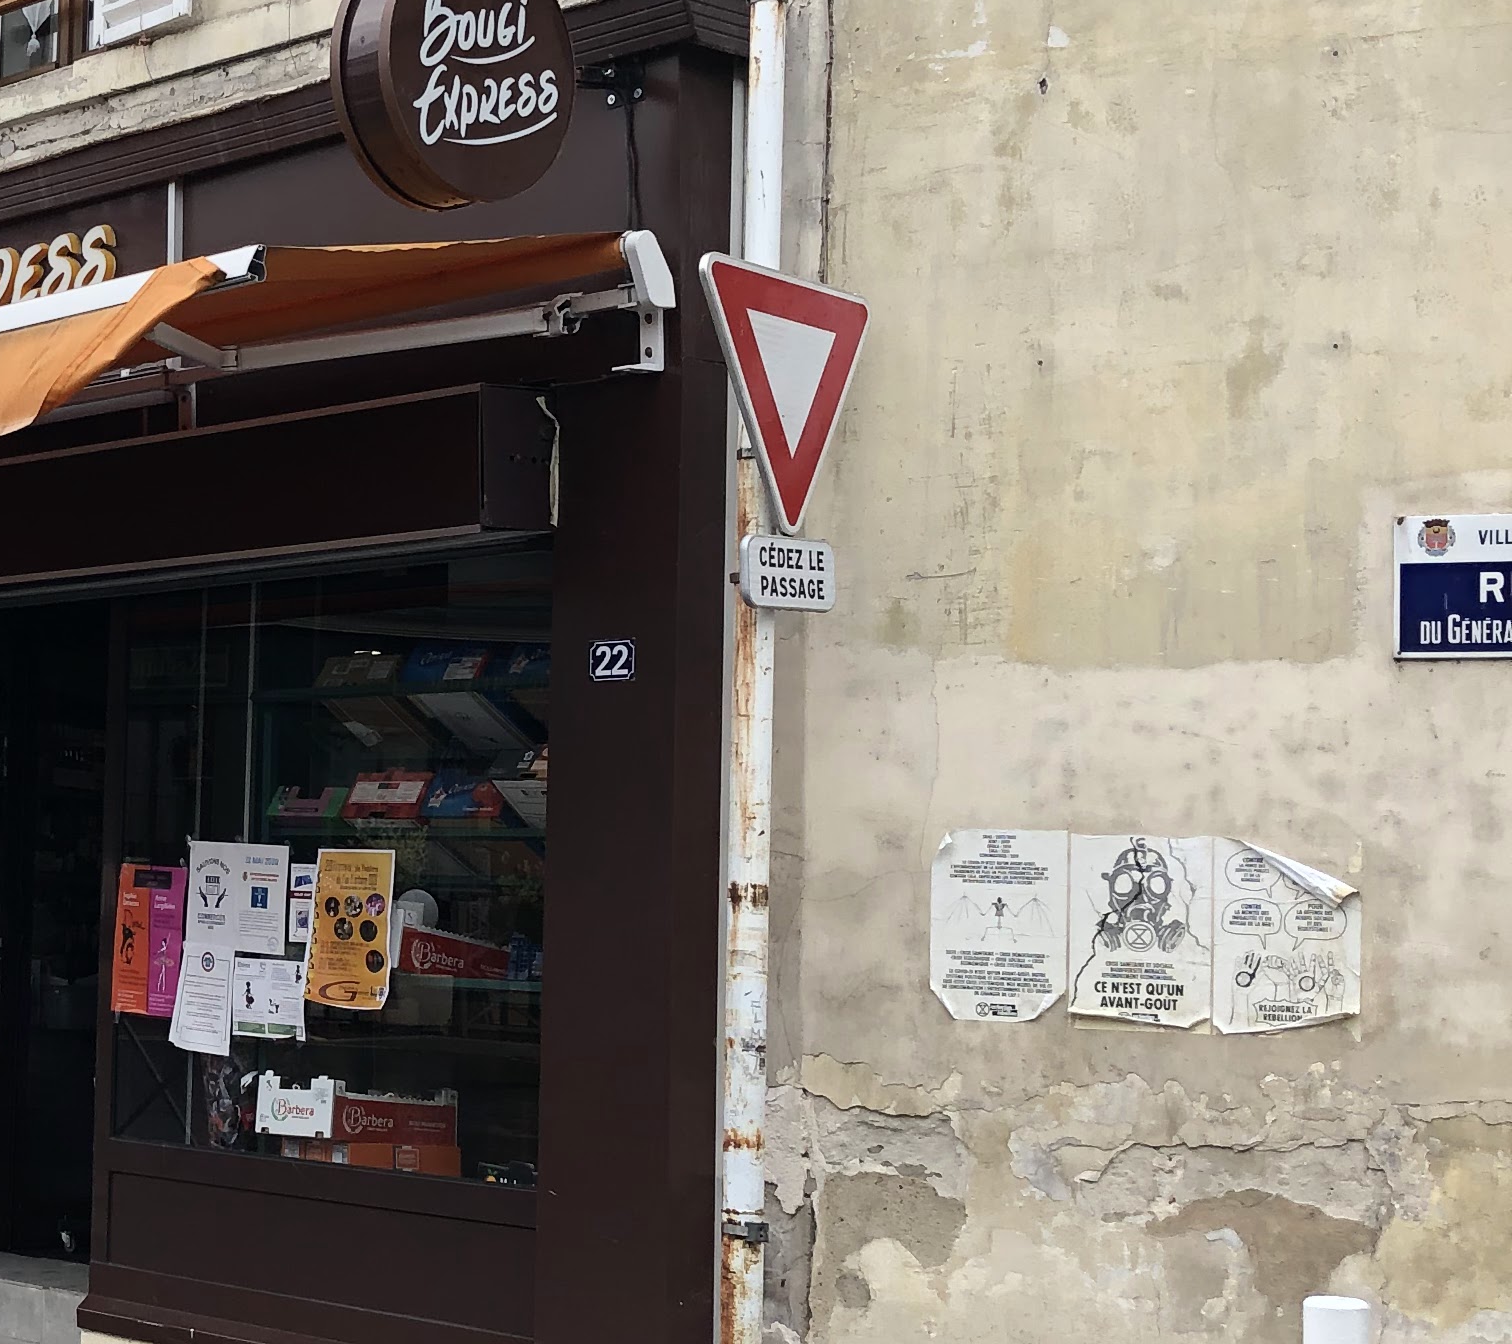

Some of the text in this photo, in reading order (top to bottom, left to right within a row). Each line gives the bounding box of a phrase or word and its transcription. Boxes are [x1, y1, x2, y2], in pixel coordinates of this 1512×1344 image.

[759, 542, 825, 571] CÉDEZ LE
[761, 575, 825, 600] PASSAGE
[1480, 571, 1512, 603] R
[1420, 621, 1442, 645] DU
[595, 645, 629, 676] 22
[416, 941, 465, 969] Barbera
[1094, 981, 1184, 996] CE N'EST QU'UN
[1259, 1004, 1312, 1014] REJOIGNEZ LA
[275, 1098, 315, 1117] Barbera
[348, 1105, 394, 1128] Barbera
